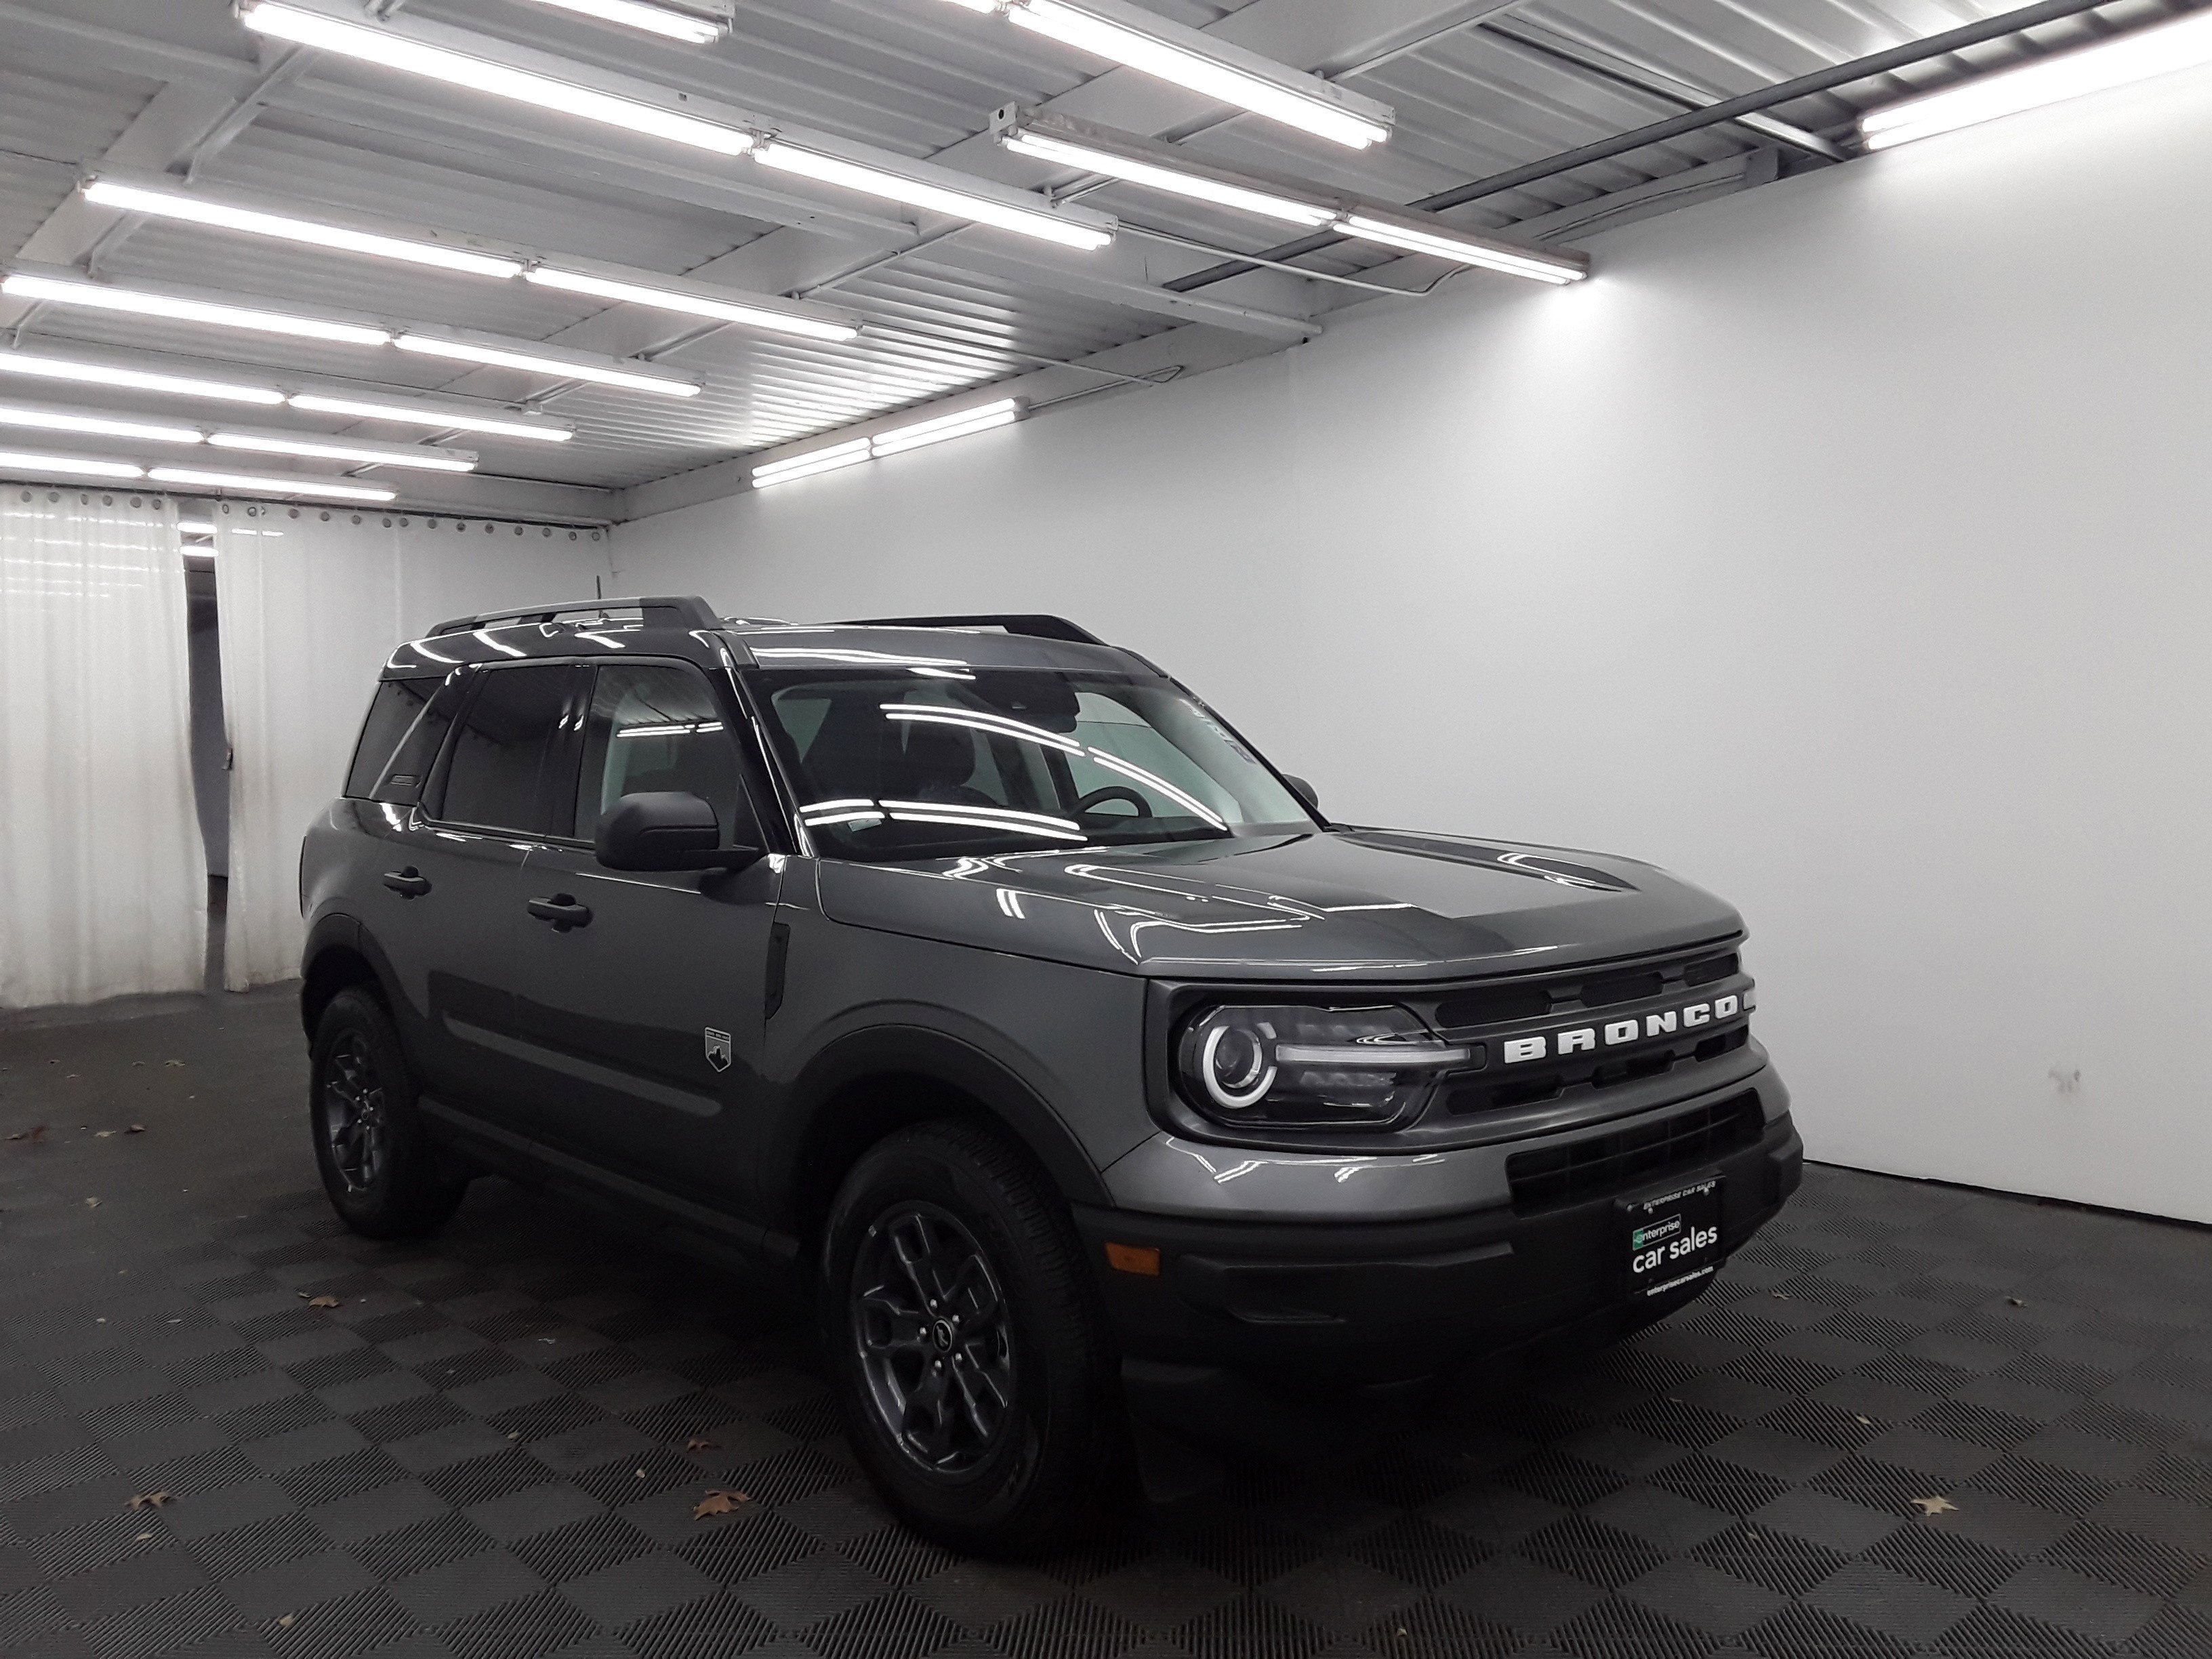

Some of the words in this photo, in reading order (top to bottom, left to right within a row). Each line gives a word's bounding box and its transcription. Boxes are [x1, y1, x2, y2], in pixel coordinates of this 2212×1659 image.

[1503, 994, 1738, 1064] BRONCO
[1633, 1246, 1666, 1273] car
[1669, 1226, 1717, 1259] sales
[1634, 1221, 1680, 1244] enterprise
